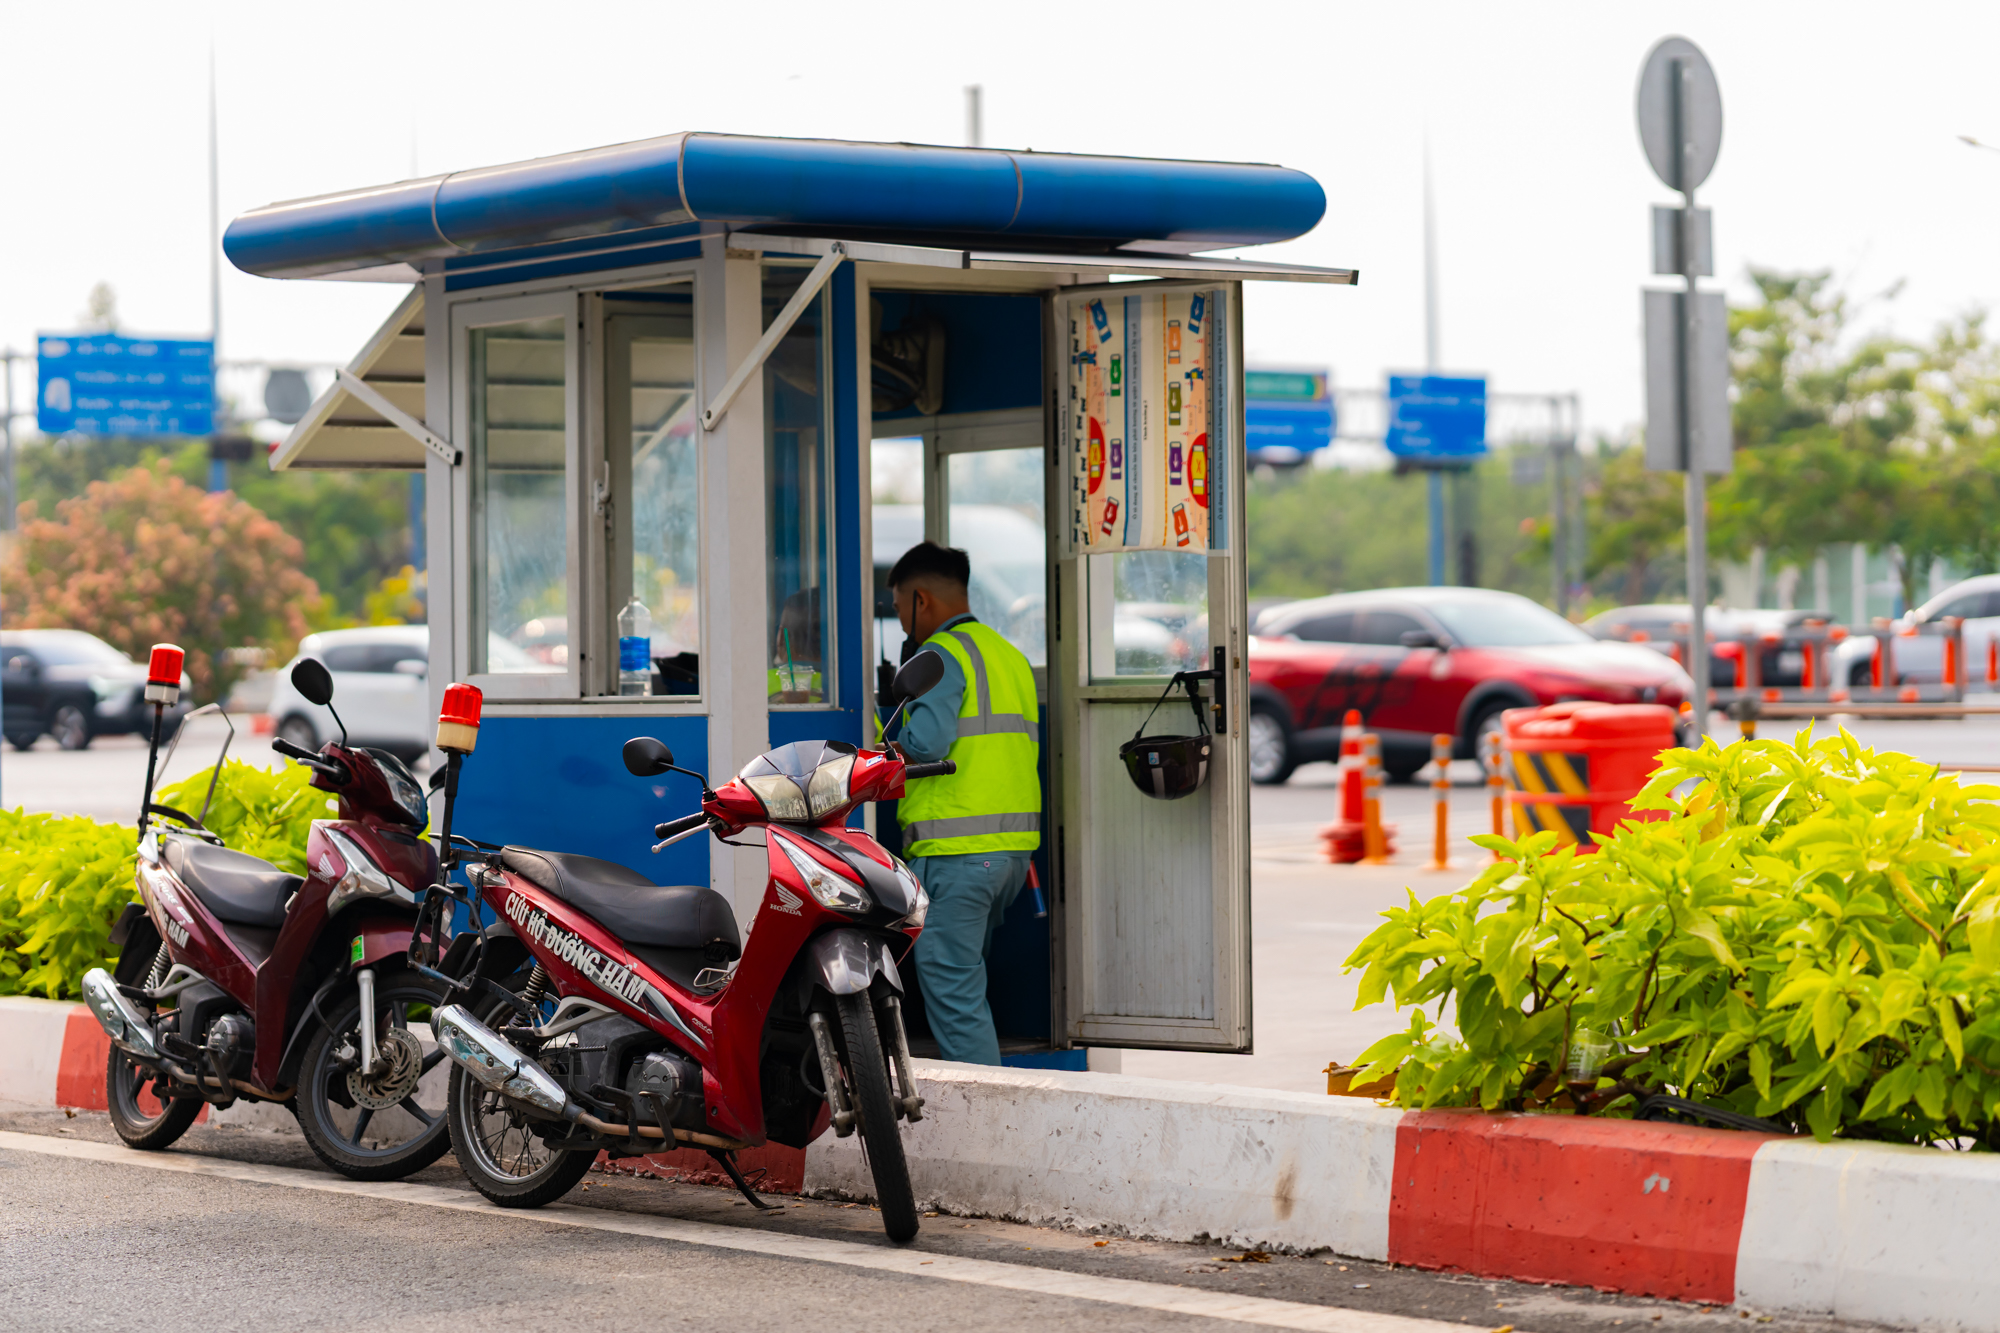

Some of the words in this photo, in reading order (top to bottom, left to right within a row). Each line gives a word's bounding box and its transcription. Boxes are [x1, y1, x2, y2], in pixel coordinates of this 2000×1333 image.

[309, 868, 330, 885] HONDA
[770, 903, 802, 917] HONDA
[526, 912, 548, 944] HỘ
[544, 925, 600, 977] ĐƯỜNG
